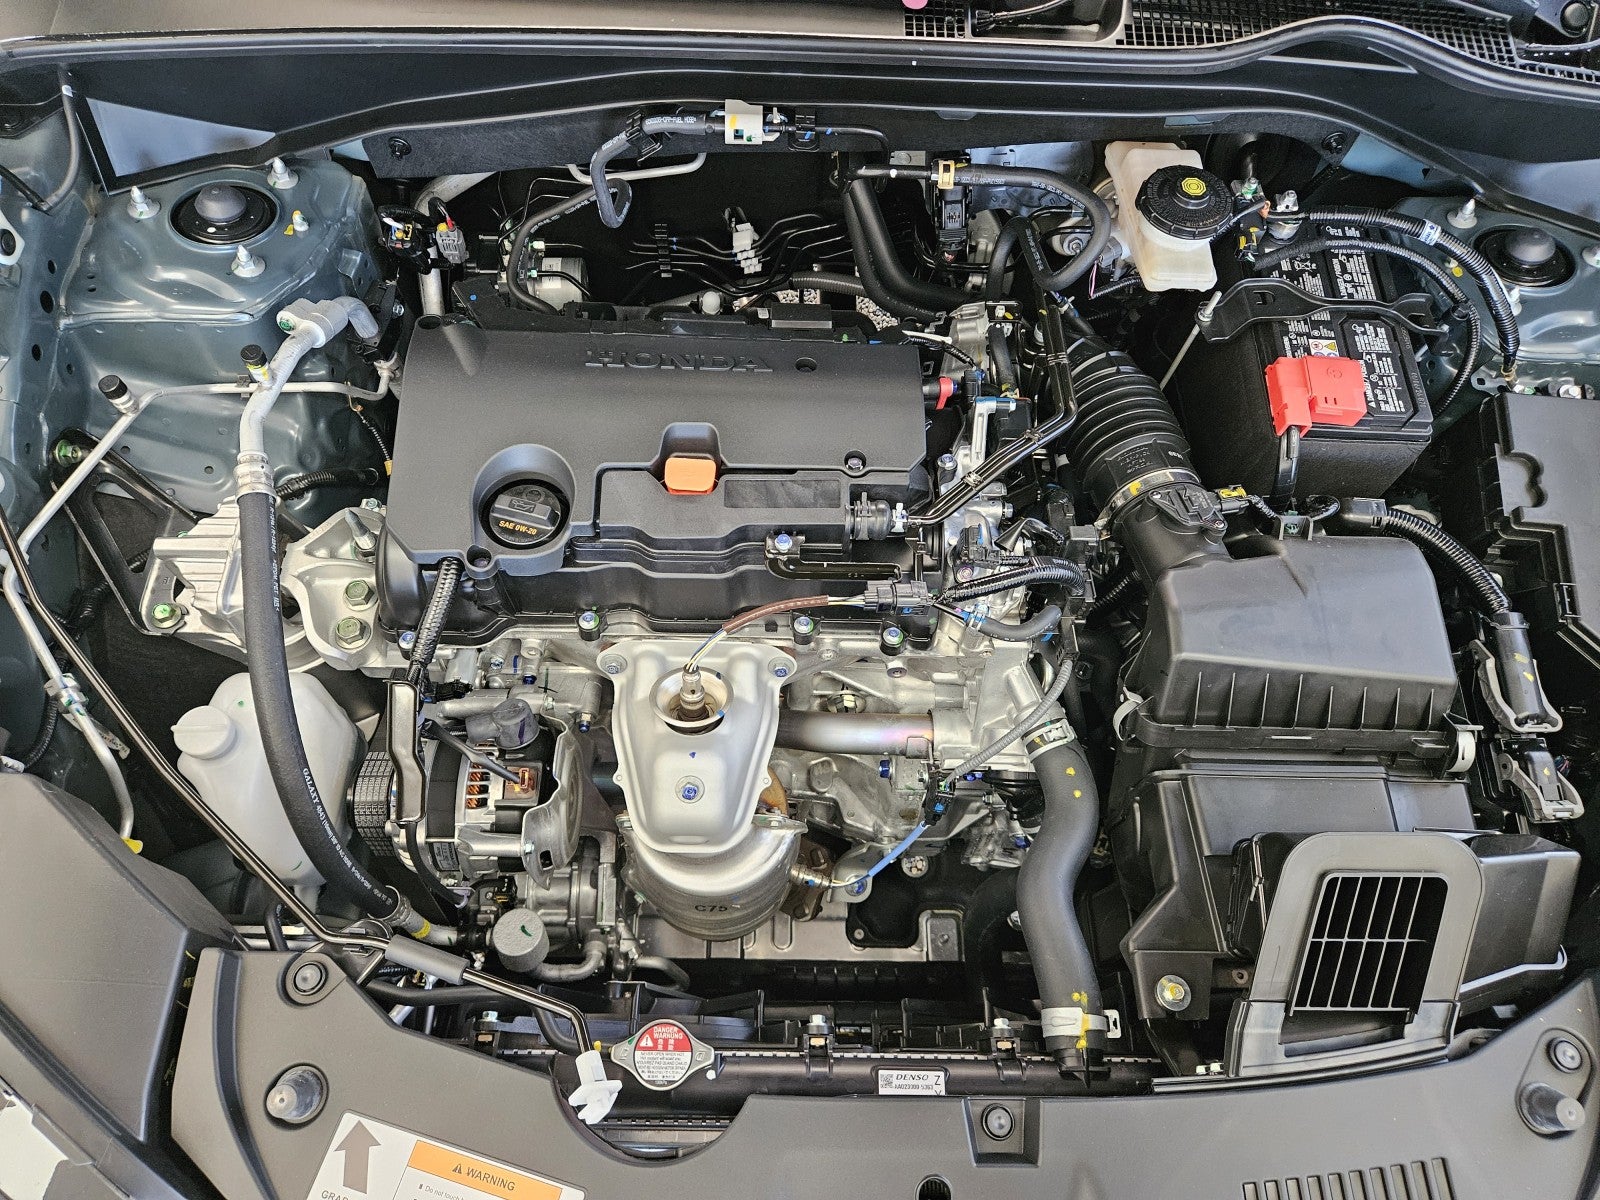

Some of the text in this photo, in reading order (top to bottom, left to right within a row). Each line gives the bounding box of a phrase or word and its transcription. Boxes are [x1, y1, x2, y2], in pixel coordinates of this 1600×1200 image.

[584, 350, 774, 373] HONDA
[498, 520, 538, 536] SAE 0W-20
[302, 767, 320, 804] GALAXY
[694, 904, 728, 913] C75
[653, 1026, 679, 1034] DANGER
[895, 1073, 941, 1086] DENSO Z
[466, 1166, 516, 1191] WARNING
[425, 1185, 434, 1194] Do
[434, 1188, 444, 1197] not
